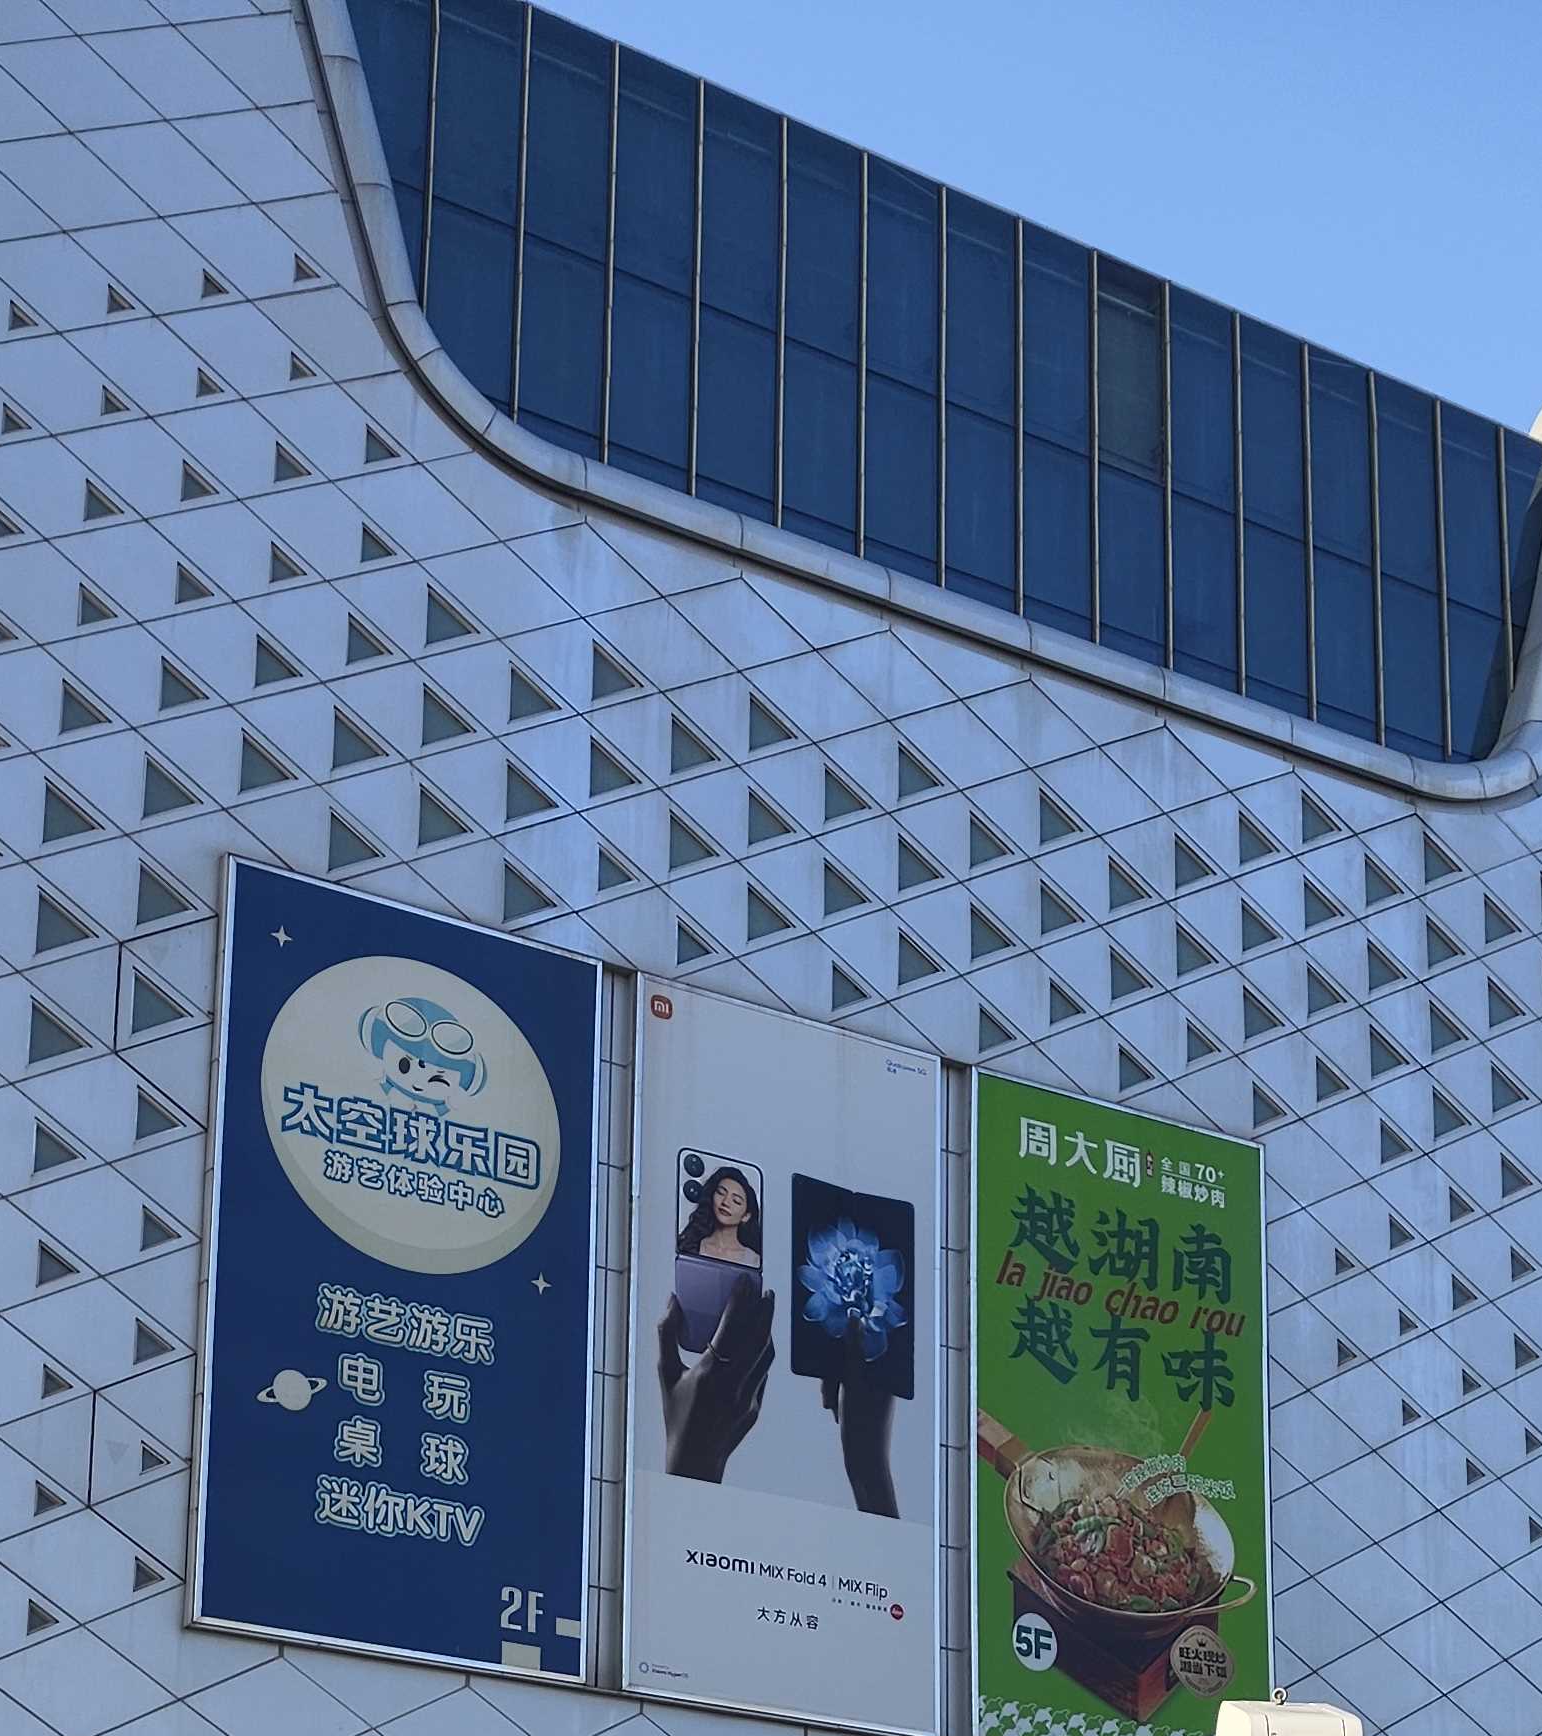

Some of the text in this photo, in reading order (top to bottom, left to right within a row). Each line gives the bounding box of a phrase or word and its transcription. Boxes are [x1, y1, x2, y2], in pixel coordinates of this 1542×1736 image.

[281, 1081, 541, 1190] 太空球乐园
[1018, 1116, 1142, 1188] 周大厨
[323, 1150, 505, 1219] 游艺体验中心
[1161, 1174, 1226, 1209] 辣椒炒肉
[1009, 1183, 1232, 1305] 越湖南
[315, 1282, 495, 1365] 游艺游乐
[996, 1250, 1246, 1337] la jiao chao rou
[1009, 1293, 1235, 1412] 越有味
[337, 1353, 470, 1424] 电 玩
[334, 1415, 469, 1485] 桌 球
[314, 1475, 486, 1548] 迷你KTV
[501, 1587, 545, 1634] 2F
[758, 1563, 784, 1581] MIX
[787, 1568, 816, 1586] Fold
[817, 1574, 828, 1588] 4
[838, 1576, 863, 1595] MIX
[865, 1582, 889, 1601] Flip
[757, 1606, 819, 1630] 大方从容
[1016, 1624, 1053, 1660] 5F
